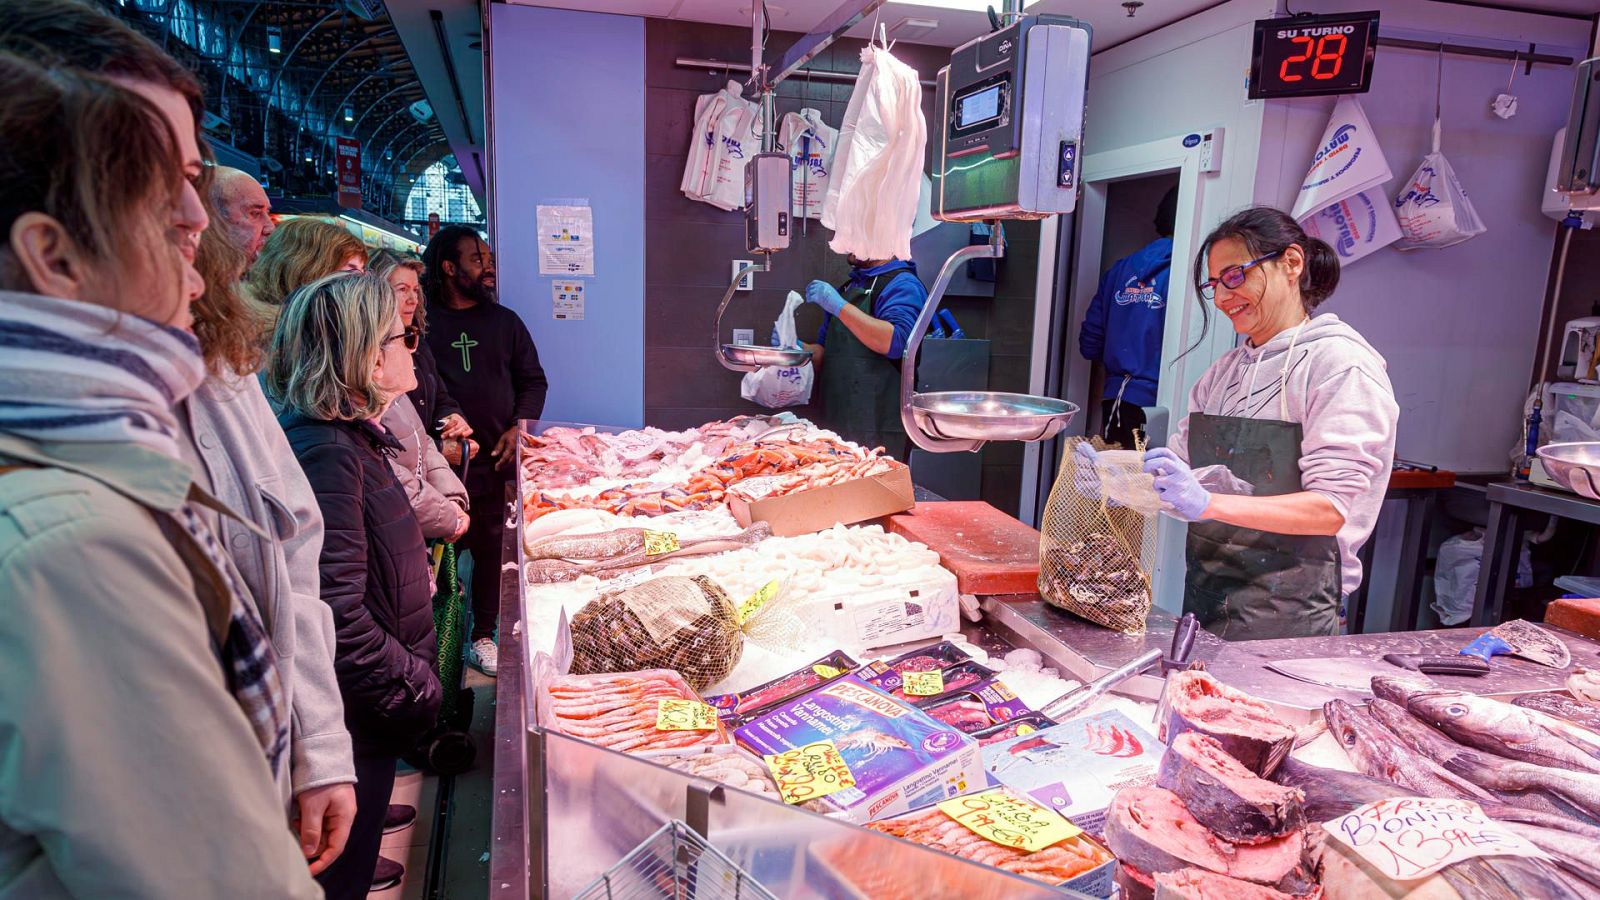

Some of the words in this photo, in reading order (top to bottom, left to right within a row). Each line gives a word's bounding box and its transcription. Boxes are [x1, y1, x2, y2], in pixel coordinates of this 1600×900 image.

[999, 41, 1012, 52] DINA
[1277, 29, 1297, 39] SU
[1302, 25, 1355, 36] TURNO
[1279, 33, 1348, 82] 28
[801, 697, 851, 731] Langostino
[828, 683, 901, 717] PESCANOVA
[790, 703, 833, 736] Vannamei
[903, 771, 933, 792] Langostino
[868, 791, 900, 817] PESCANOVA
[1341, 808, 1484, 847] BONITO
